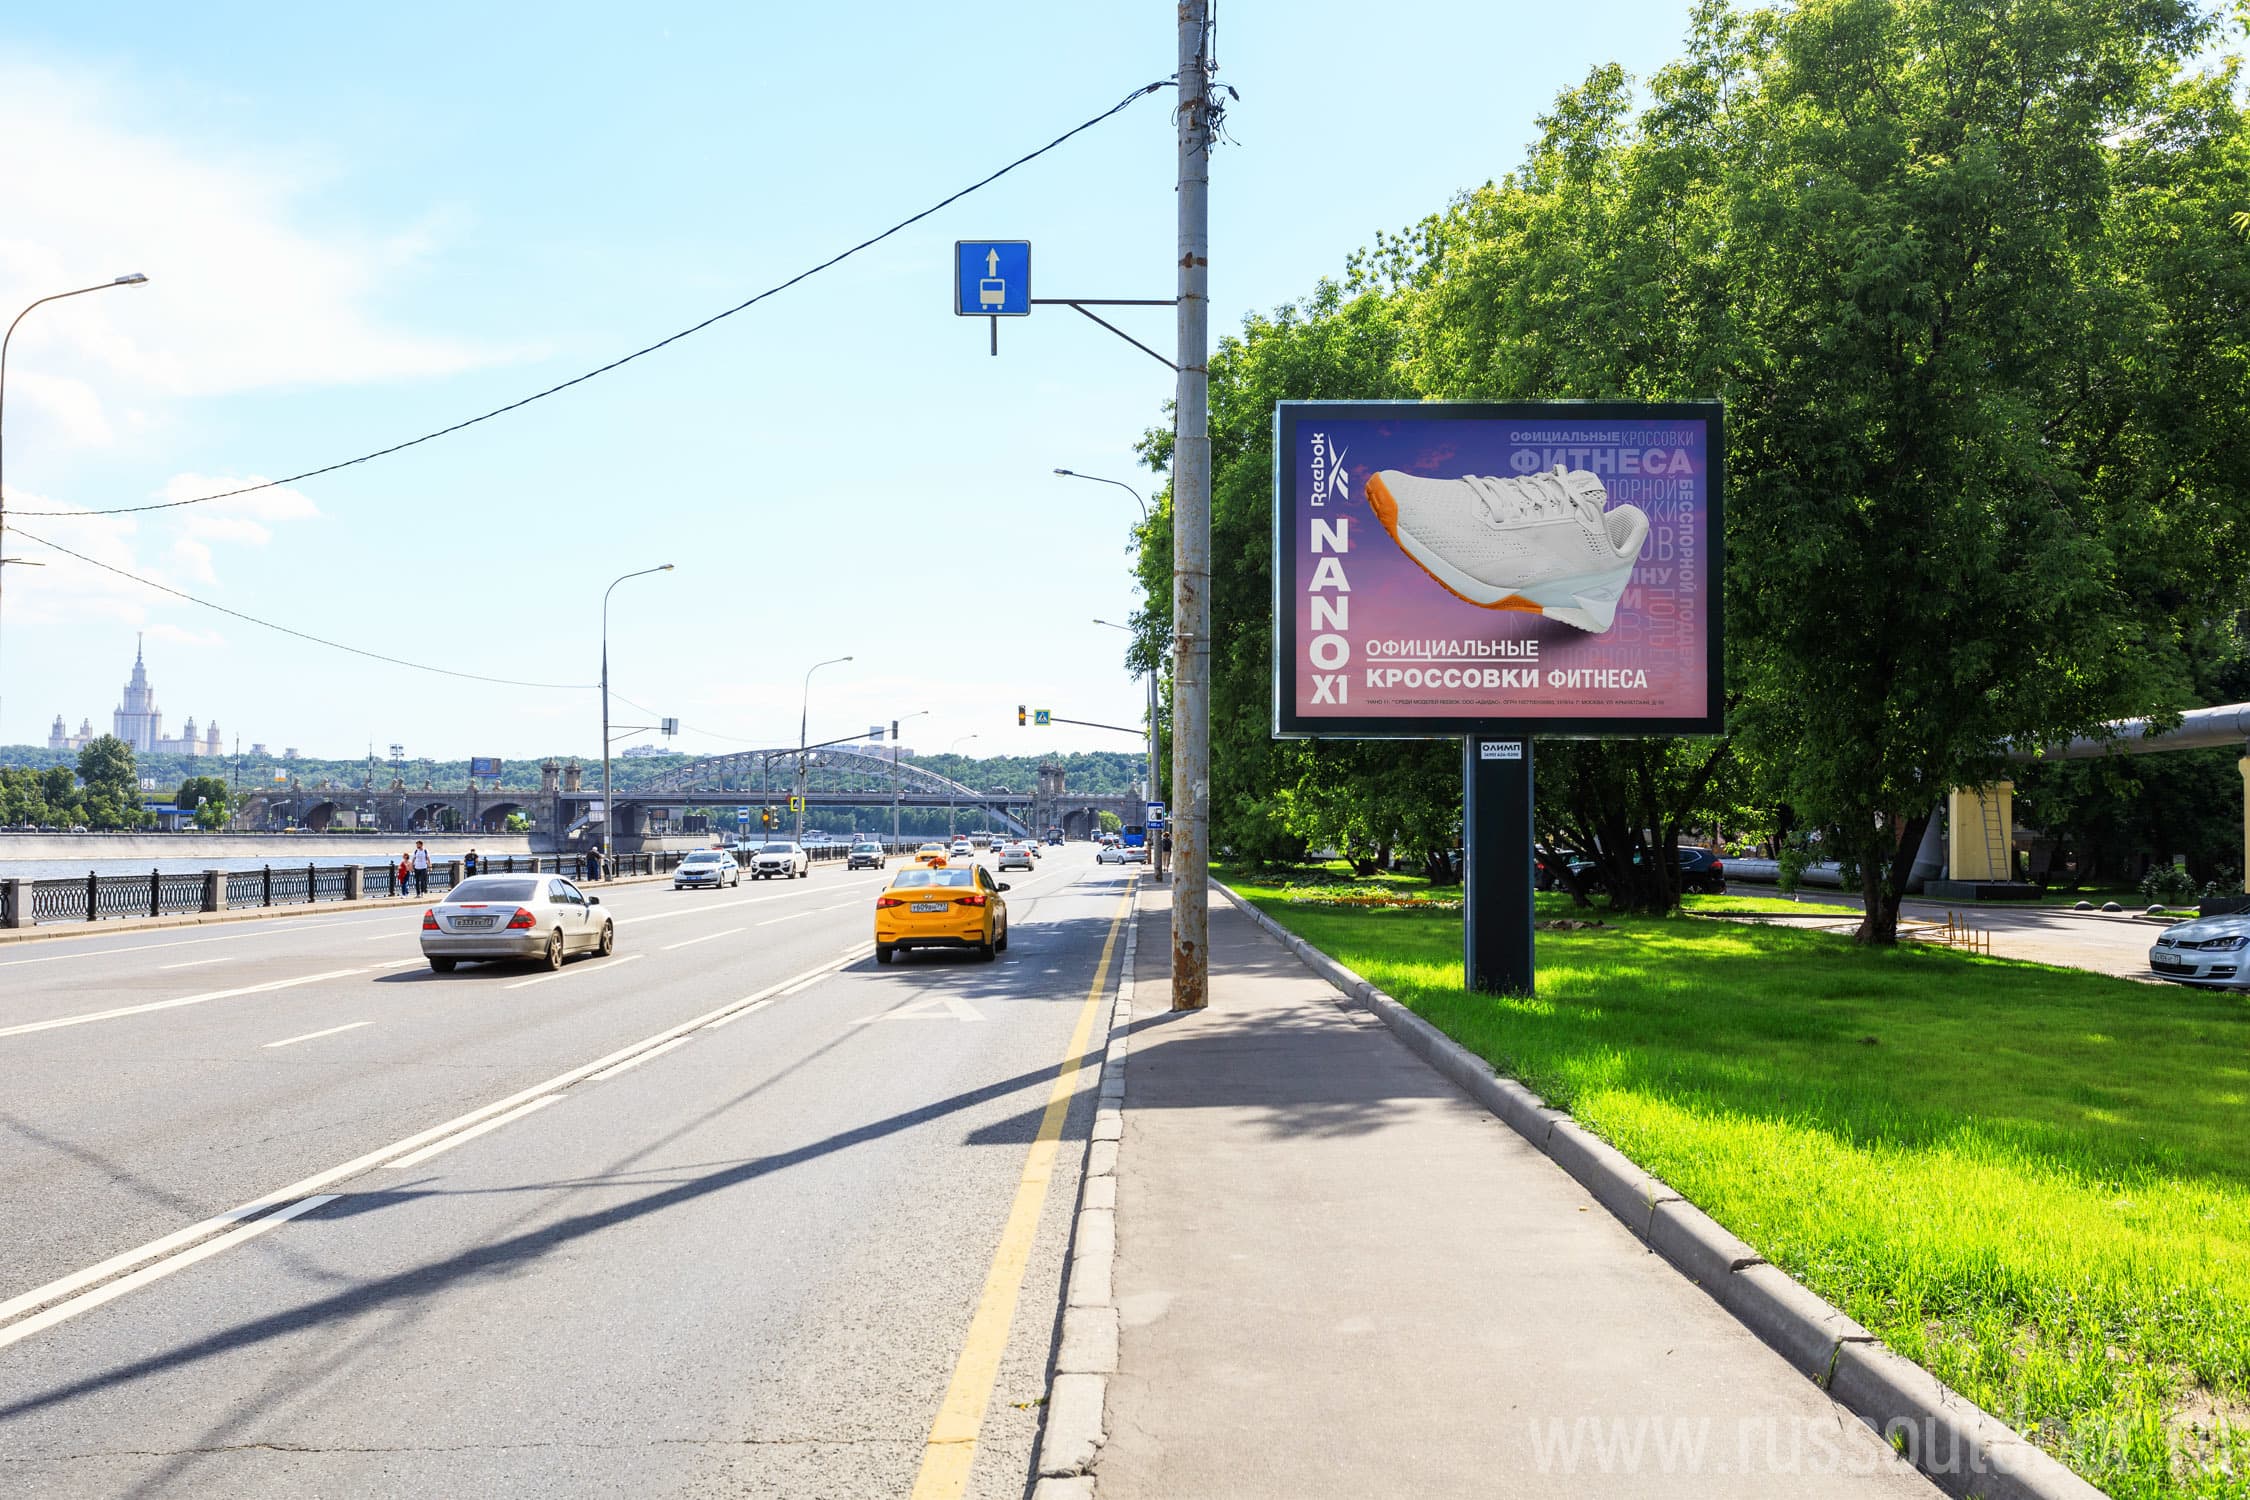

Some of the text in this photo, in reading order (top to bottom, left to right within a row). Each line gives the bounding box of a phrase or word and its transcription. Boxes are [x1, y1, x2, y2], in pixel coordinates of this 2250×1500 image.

[1510, 431, 1694, 446] ОФИЦИАЛЬНЫЕ КРОССОВКИ
[1311, 433, 1327, 507] Reebok
[1510, 448, 1694, 474] ФИТНЕСА
[1679, 479, 1697, 592] БЕССПОРНОЙ
[1308, 518, 1351, 670] NANO
[1366, 639, 1539, 658] ОФИЦИАЛЬНЫЕ
[1366, 668, 1539, 688] КРОССОВКИ
